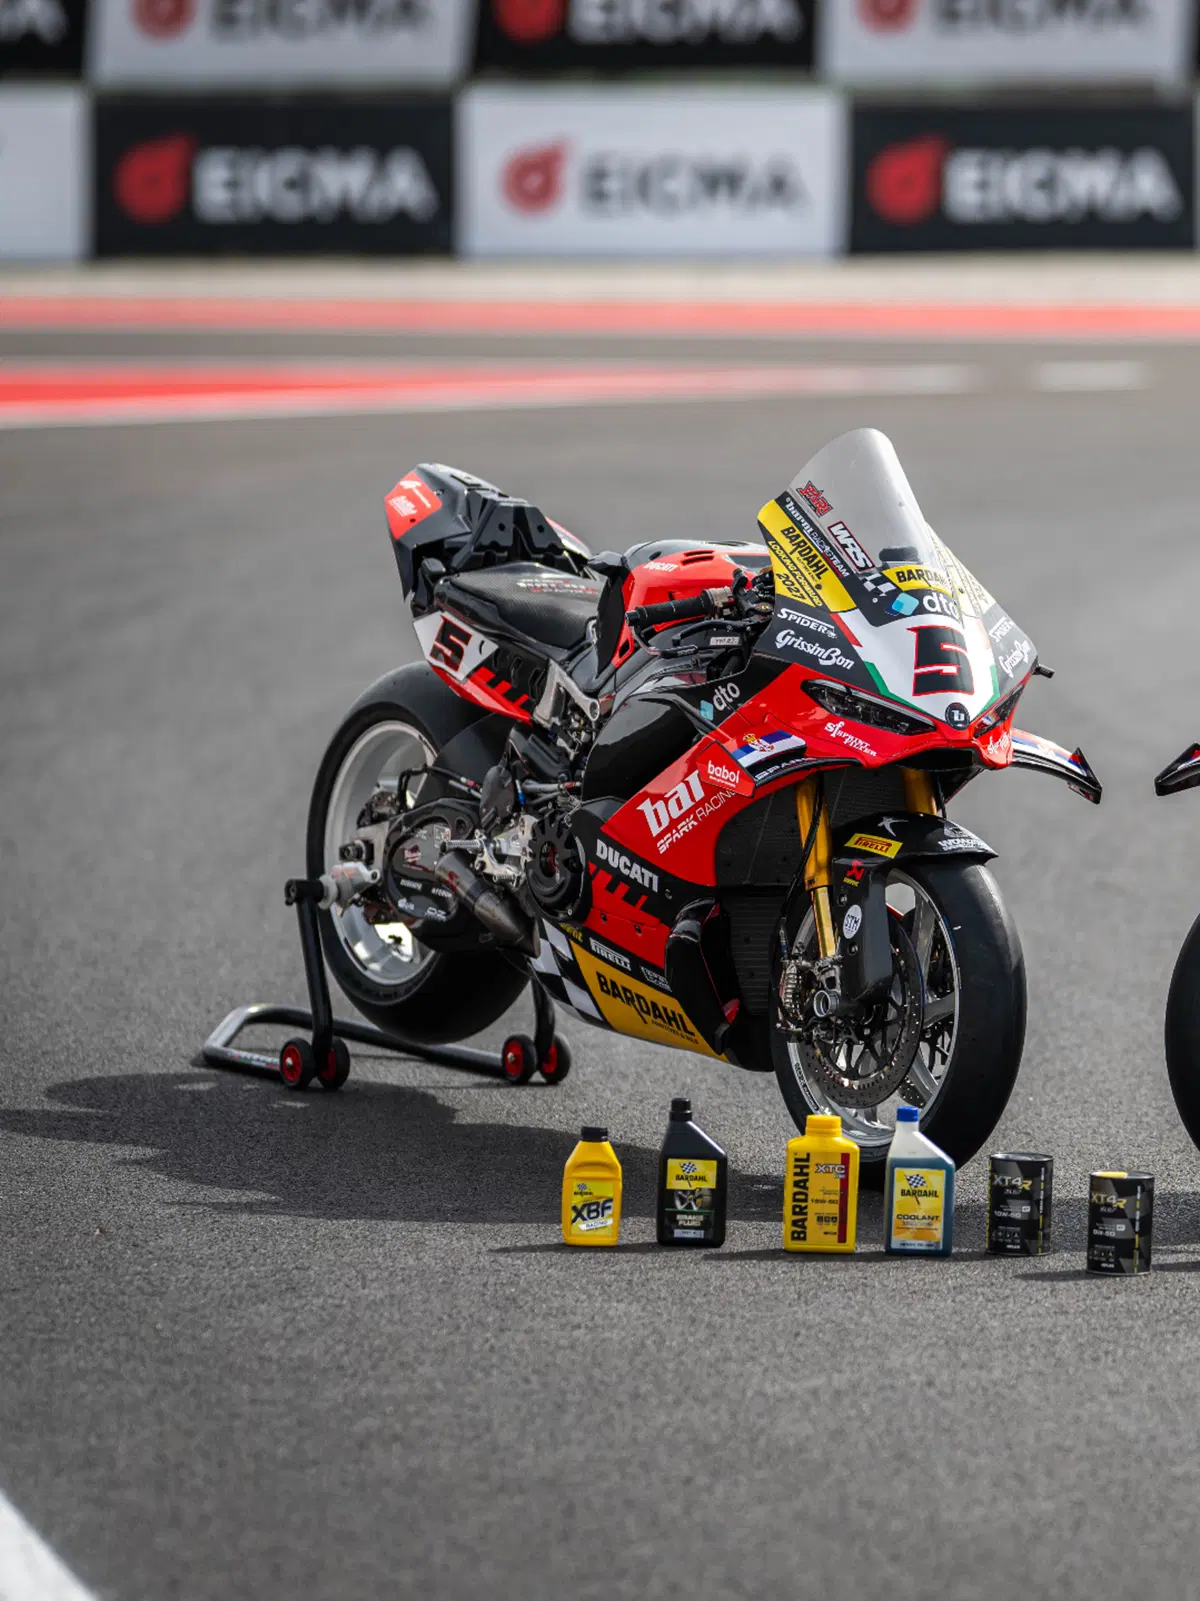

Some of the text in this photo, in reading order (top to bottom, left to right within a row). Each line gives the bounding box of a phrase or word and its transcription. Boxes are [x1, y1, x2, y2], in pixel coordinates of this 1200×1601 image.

[194, 147, 437, 223] EICMA
[580, 152, 811, 219] EICMA
[944, 148, 1183, 223] EICMA
[780, 526, 829, 580] BARDAHL
[829, 522, 872, 571] WRS
[767, 540, 797, 571] LOOKING
[790, 569, 823, 606] FORWARD
[776, 573, 806, 600] 2027
[777, 608, 834, 634] SPIDER
[430, 614, 472, 672] 5
[775, 629, 855, 670] GrissinBon
[906, 625, 974, 696] 5
[712, 682, 740, 711] dto
[707, 760, 740, 783] babol
[657, 814, 698, 854] SPARK
[854, 837, 893, 853] PIRELLI
[596, 839, 659, 893] DUCATI
[589, 937, 631, 971] PIRELLI
[596, 971, 695, 1037] BARDAHL
[675, 1174, 707, 1184] BARDAHL
[815, 1163, 846, 1174] XTC
[571, 1198, 613, 1224] XBF
[790, 1152, 810, 1241] BARDAHL
[901, 1189, 939, 1199] BARDAHL
[896, 1213, 940, 1221] COOLANT
